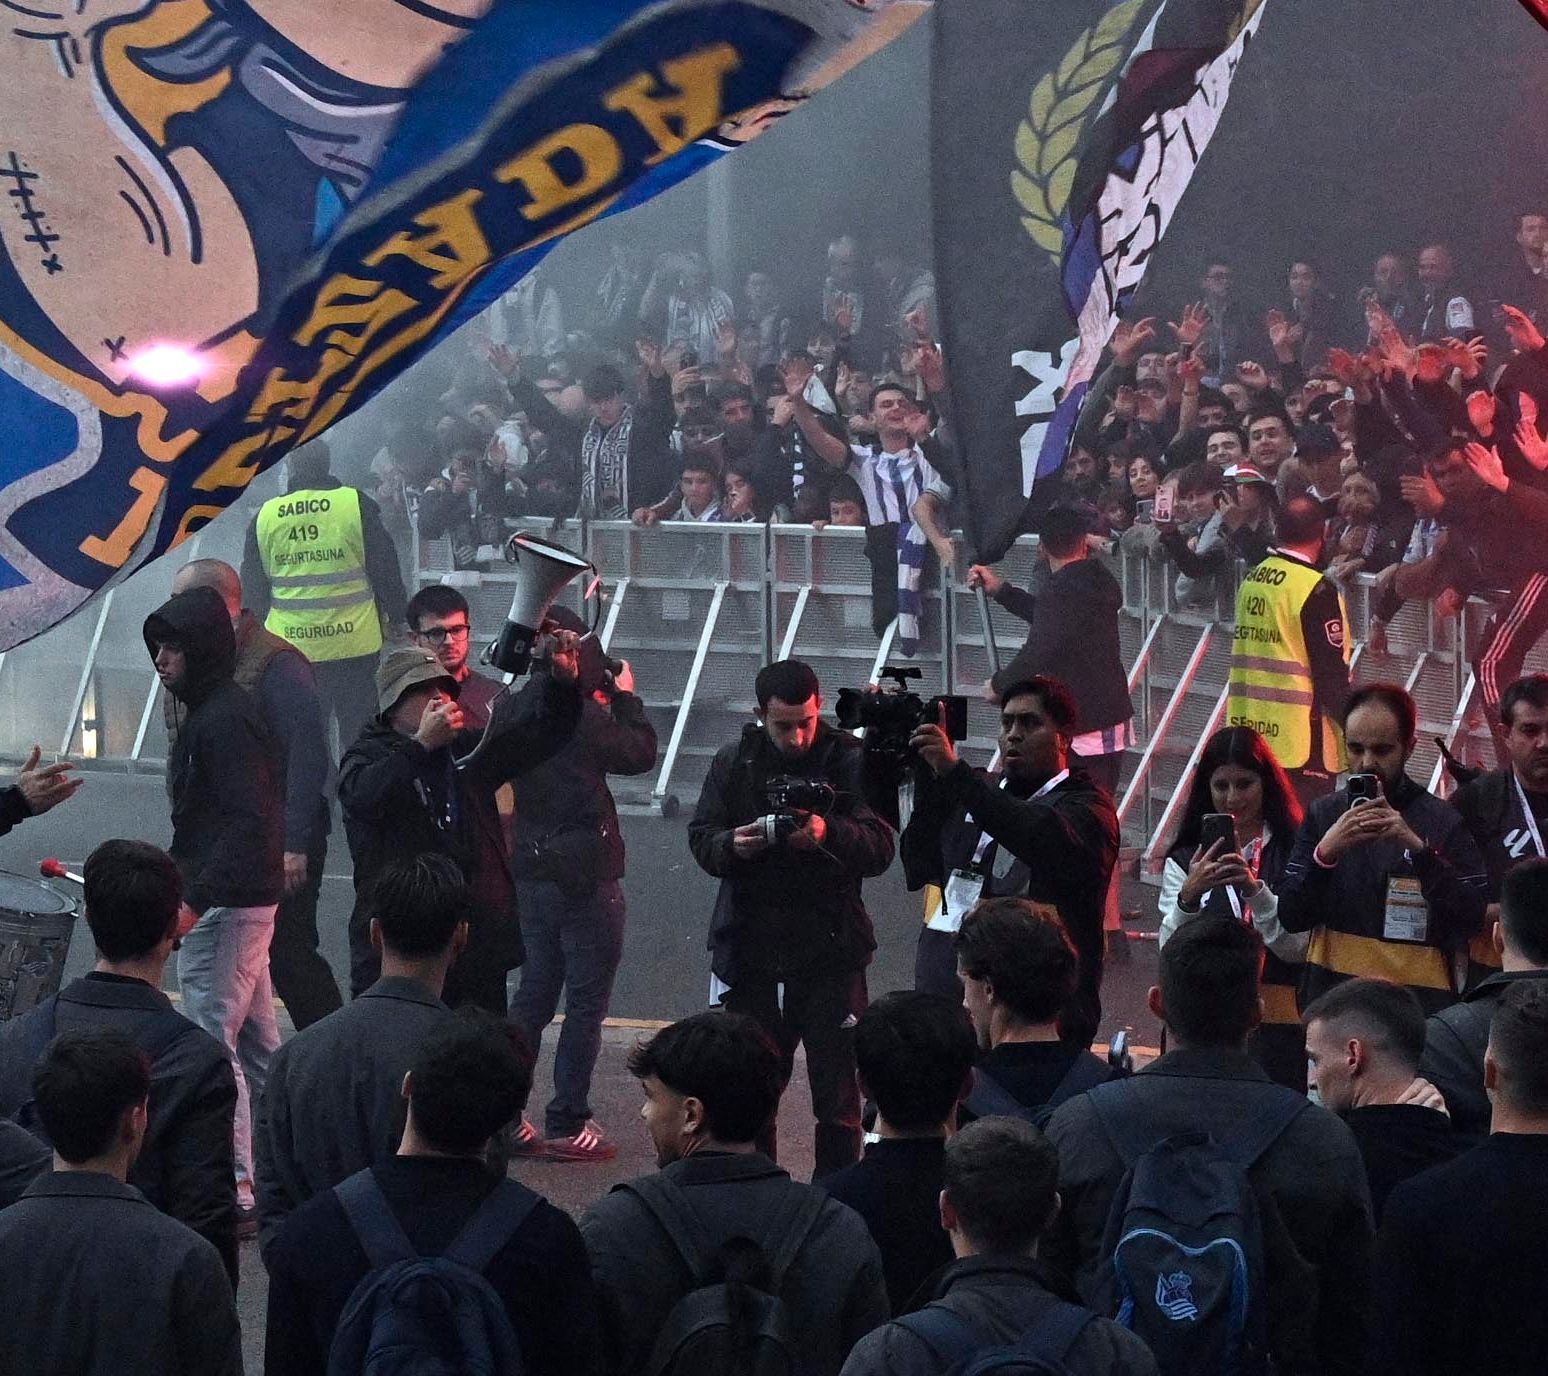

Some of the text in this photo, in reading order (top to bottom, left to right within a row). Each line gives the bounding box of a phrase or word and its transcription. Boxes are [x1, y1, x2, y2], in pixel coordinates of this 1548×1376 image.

[278, 499, 330, 518] SABICO
[288, 524, 319, 542] 419
[274, 548, 345, 566] SEGURTASUNA
[284, 621, 354, 639] SEGURIDAD
